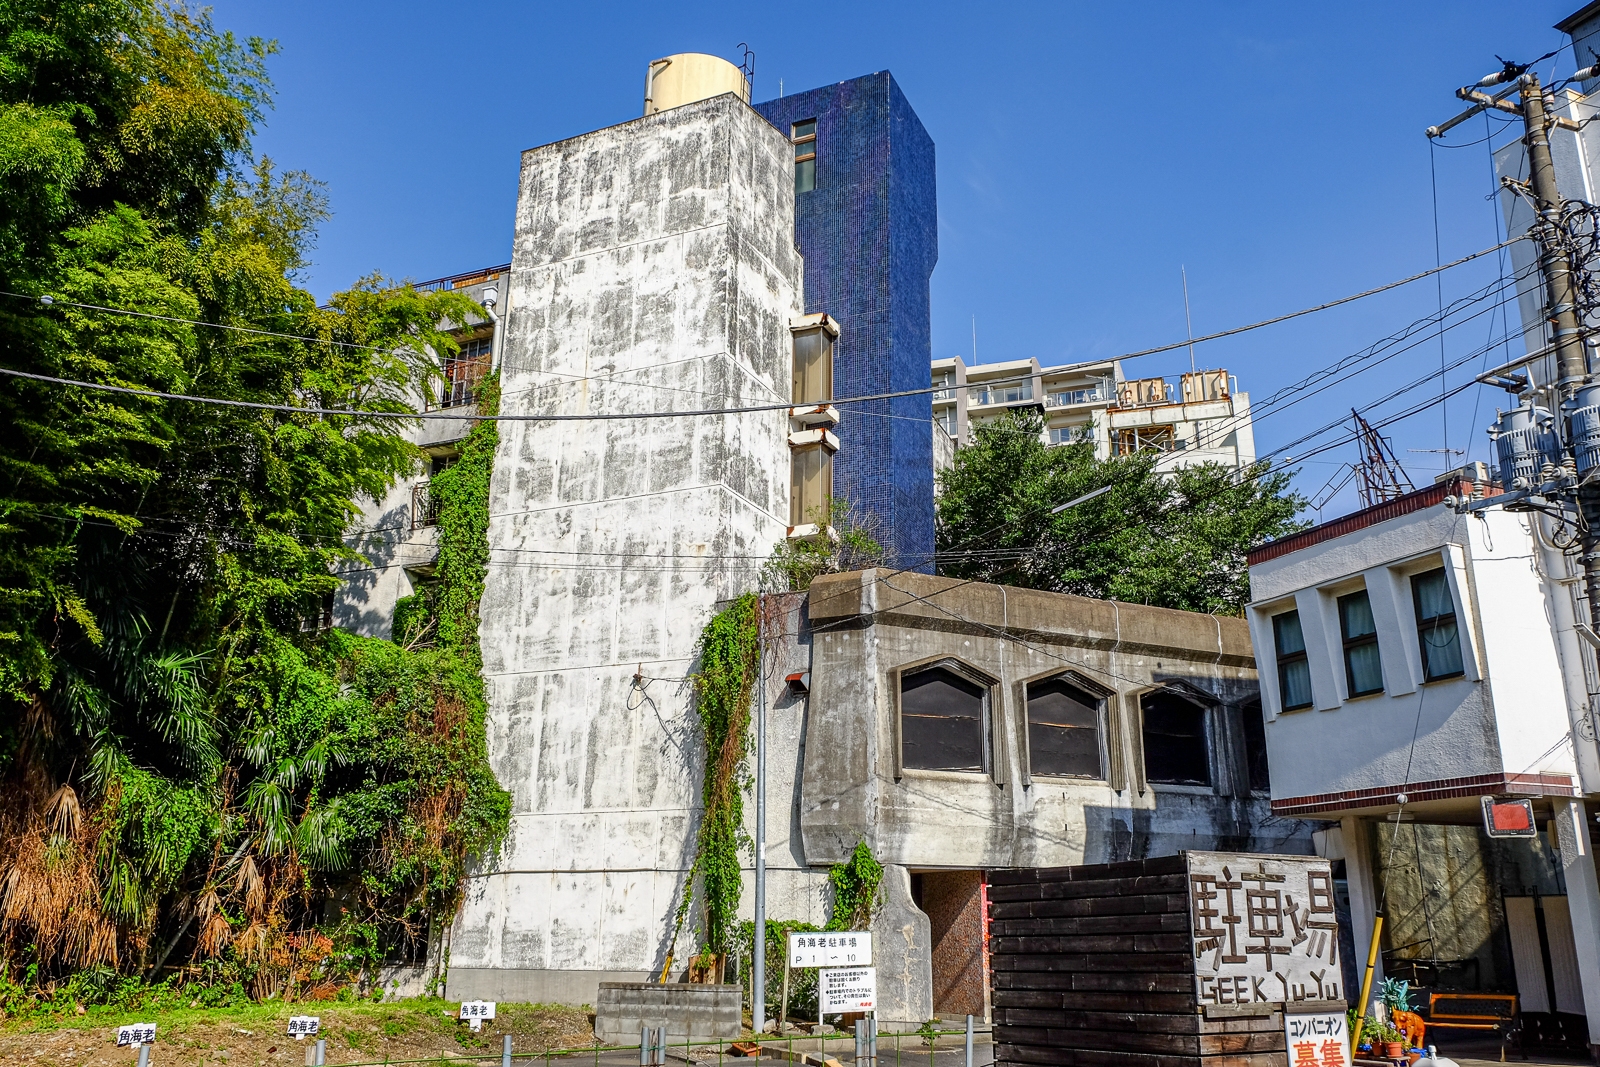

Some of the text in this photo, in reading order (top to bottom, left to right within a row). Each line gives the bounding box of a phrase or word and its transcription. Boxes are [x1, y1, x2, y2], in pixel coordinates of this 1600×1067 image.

[1190, 862, 1338, 971] 駐車場
[797, 937, 857, 948] 角海老駐車場
[1200, 976, 1268, 1004] GEEK
[461, 1005, 488, 1016] 角海老
[288, 1020, 318, 1032] 角海老
[1290, 1016, 1342, 1038] コンパニオン
[118, 1028, 155, 1044] 角海老
